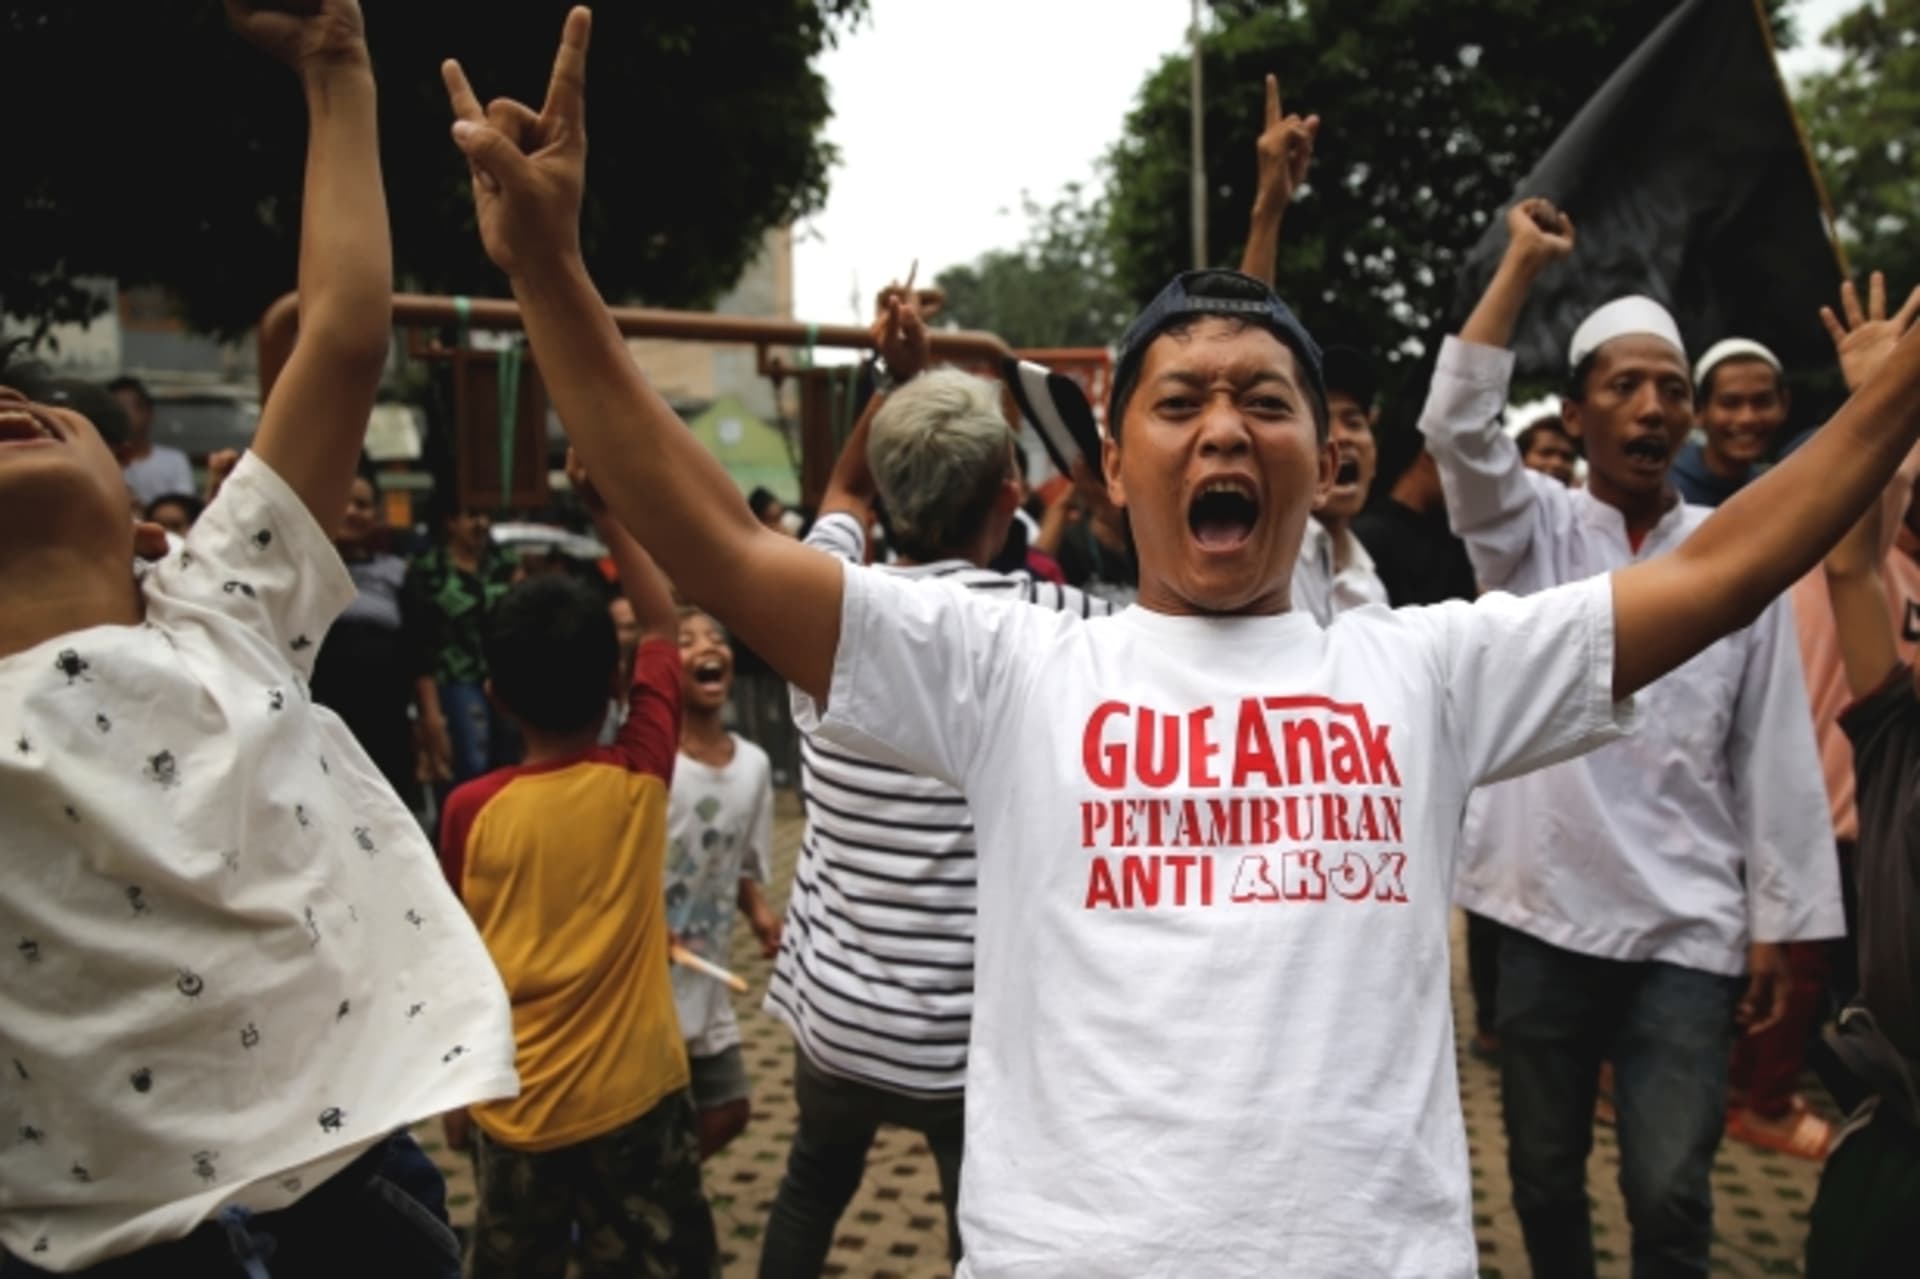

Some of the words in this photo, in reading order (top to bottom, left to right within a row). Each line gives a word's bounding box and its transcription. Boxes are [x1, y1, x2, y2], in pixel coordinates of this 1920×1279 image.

[1082, 700, 1220, 789] GUE
[1232, 694, 1402, 788] Anak
[1080, 793, 1403, 848] PETAMBURAN
[1085, 854, 1213, 909] ANTI
